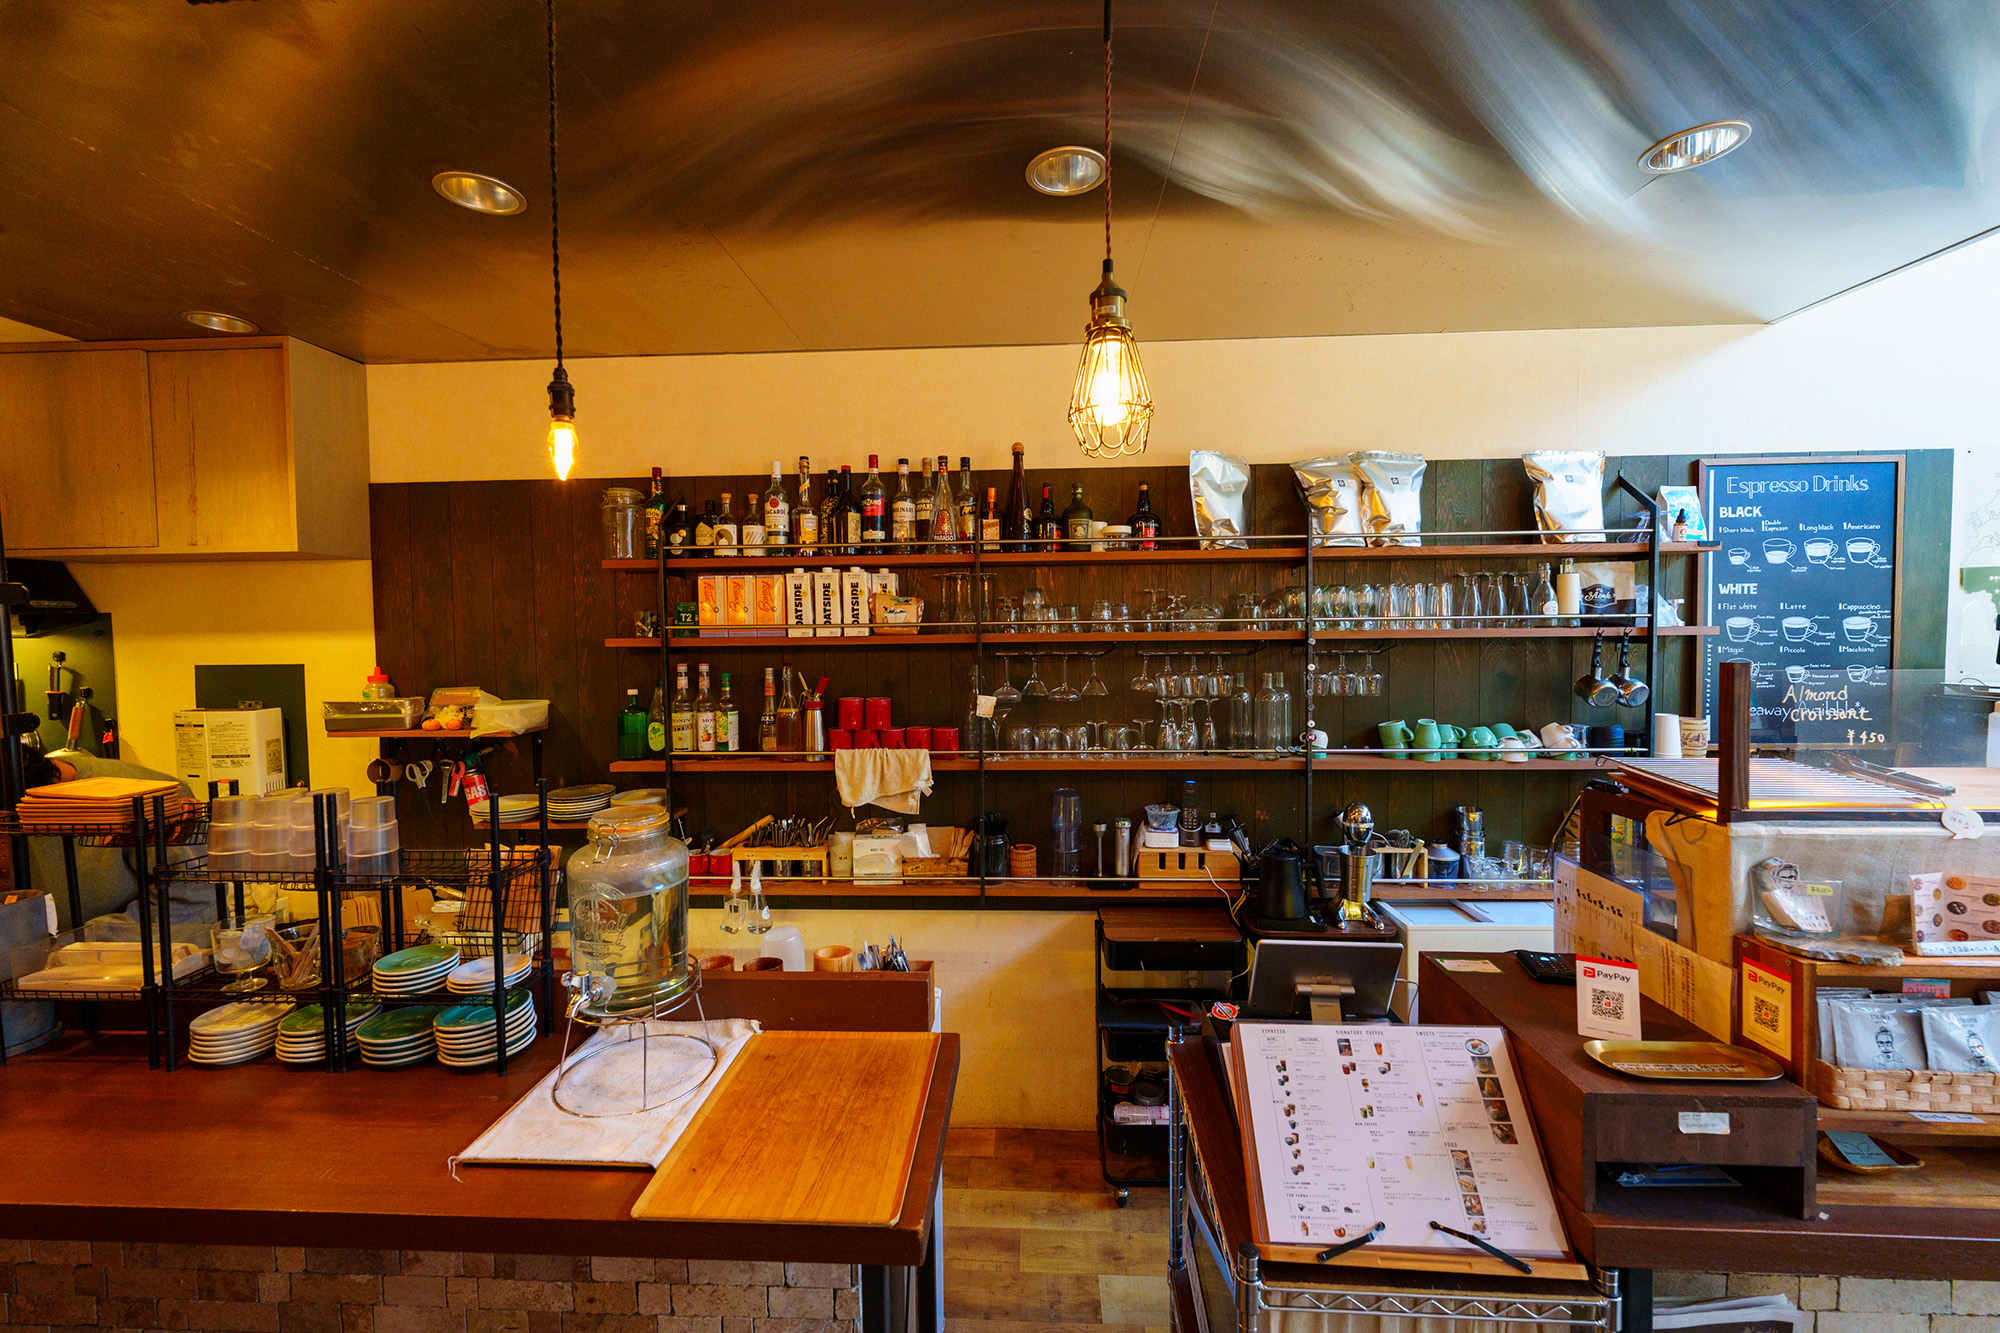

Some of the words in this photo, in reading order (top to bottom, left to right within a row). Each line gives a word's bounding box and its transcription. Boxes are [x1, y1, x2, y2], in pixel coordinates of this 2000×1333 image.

[1726, 476, 1810, 499] Espresso
[1812, 474, 1870, 492] Drinks
[1719, 506, 1762, 518] BLACK
[1722, 526, 1738, 534] Short
[1740, 526, 1755, 534] black
[1764, 524, 1788, 532] Espresso
[1802, 524, 1818, 534] Long
[1846, 522, 1881, 530] Americano
[1718, 583, 1758, 594] WHITE
[1722, 602, 1737, 610] Flat
[1738, 602, 1757, 610] white
[1785, 602, 1806, 610] Latte
[1842, 602, 1881, 612] Cappuccino
[680, 613, 692, 622] T2
[1722, 646, 1744, 656] Magic
[1782, 685, 1848, 704] Almond
[464, 784, 487, 800] GAS
[1597, 970, 1631, 984] PayPay
[1758, 976, 1785, 994] PayPay
